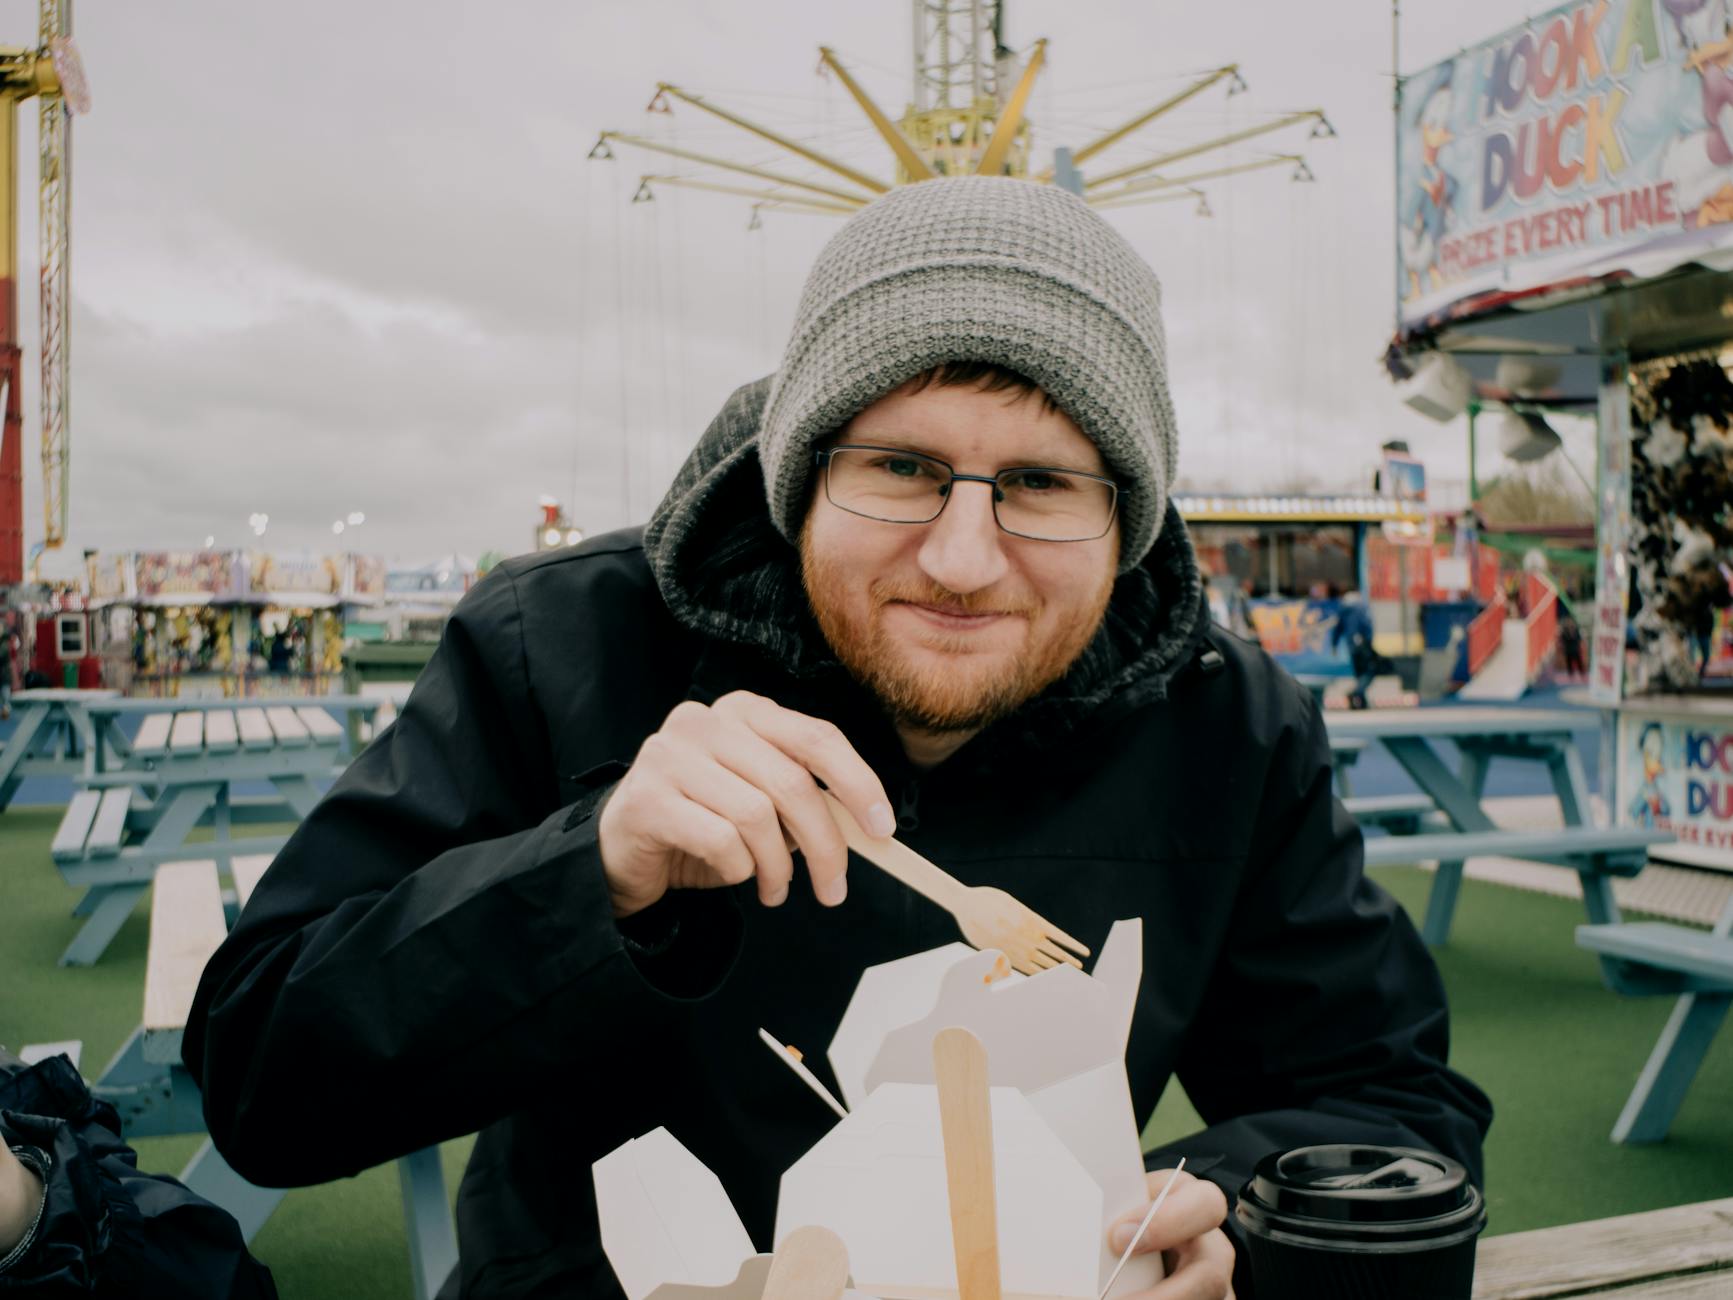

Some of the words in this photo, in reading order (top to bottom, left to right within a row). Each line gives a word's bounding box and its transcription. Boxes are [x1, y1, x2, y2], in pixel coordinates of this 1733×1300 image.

[1611, 0, 1661, 73] A
[1482, 88, 1628, 211] DUCK
[1440, 226, 1497, 275] PRIZE
[1504, 203, 1590, 258] EVERY
[1596, 181, 1676, 236] TIME
